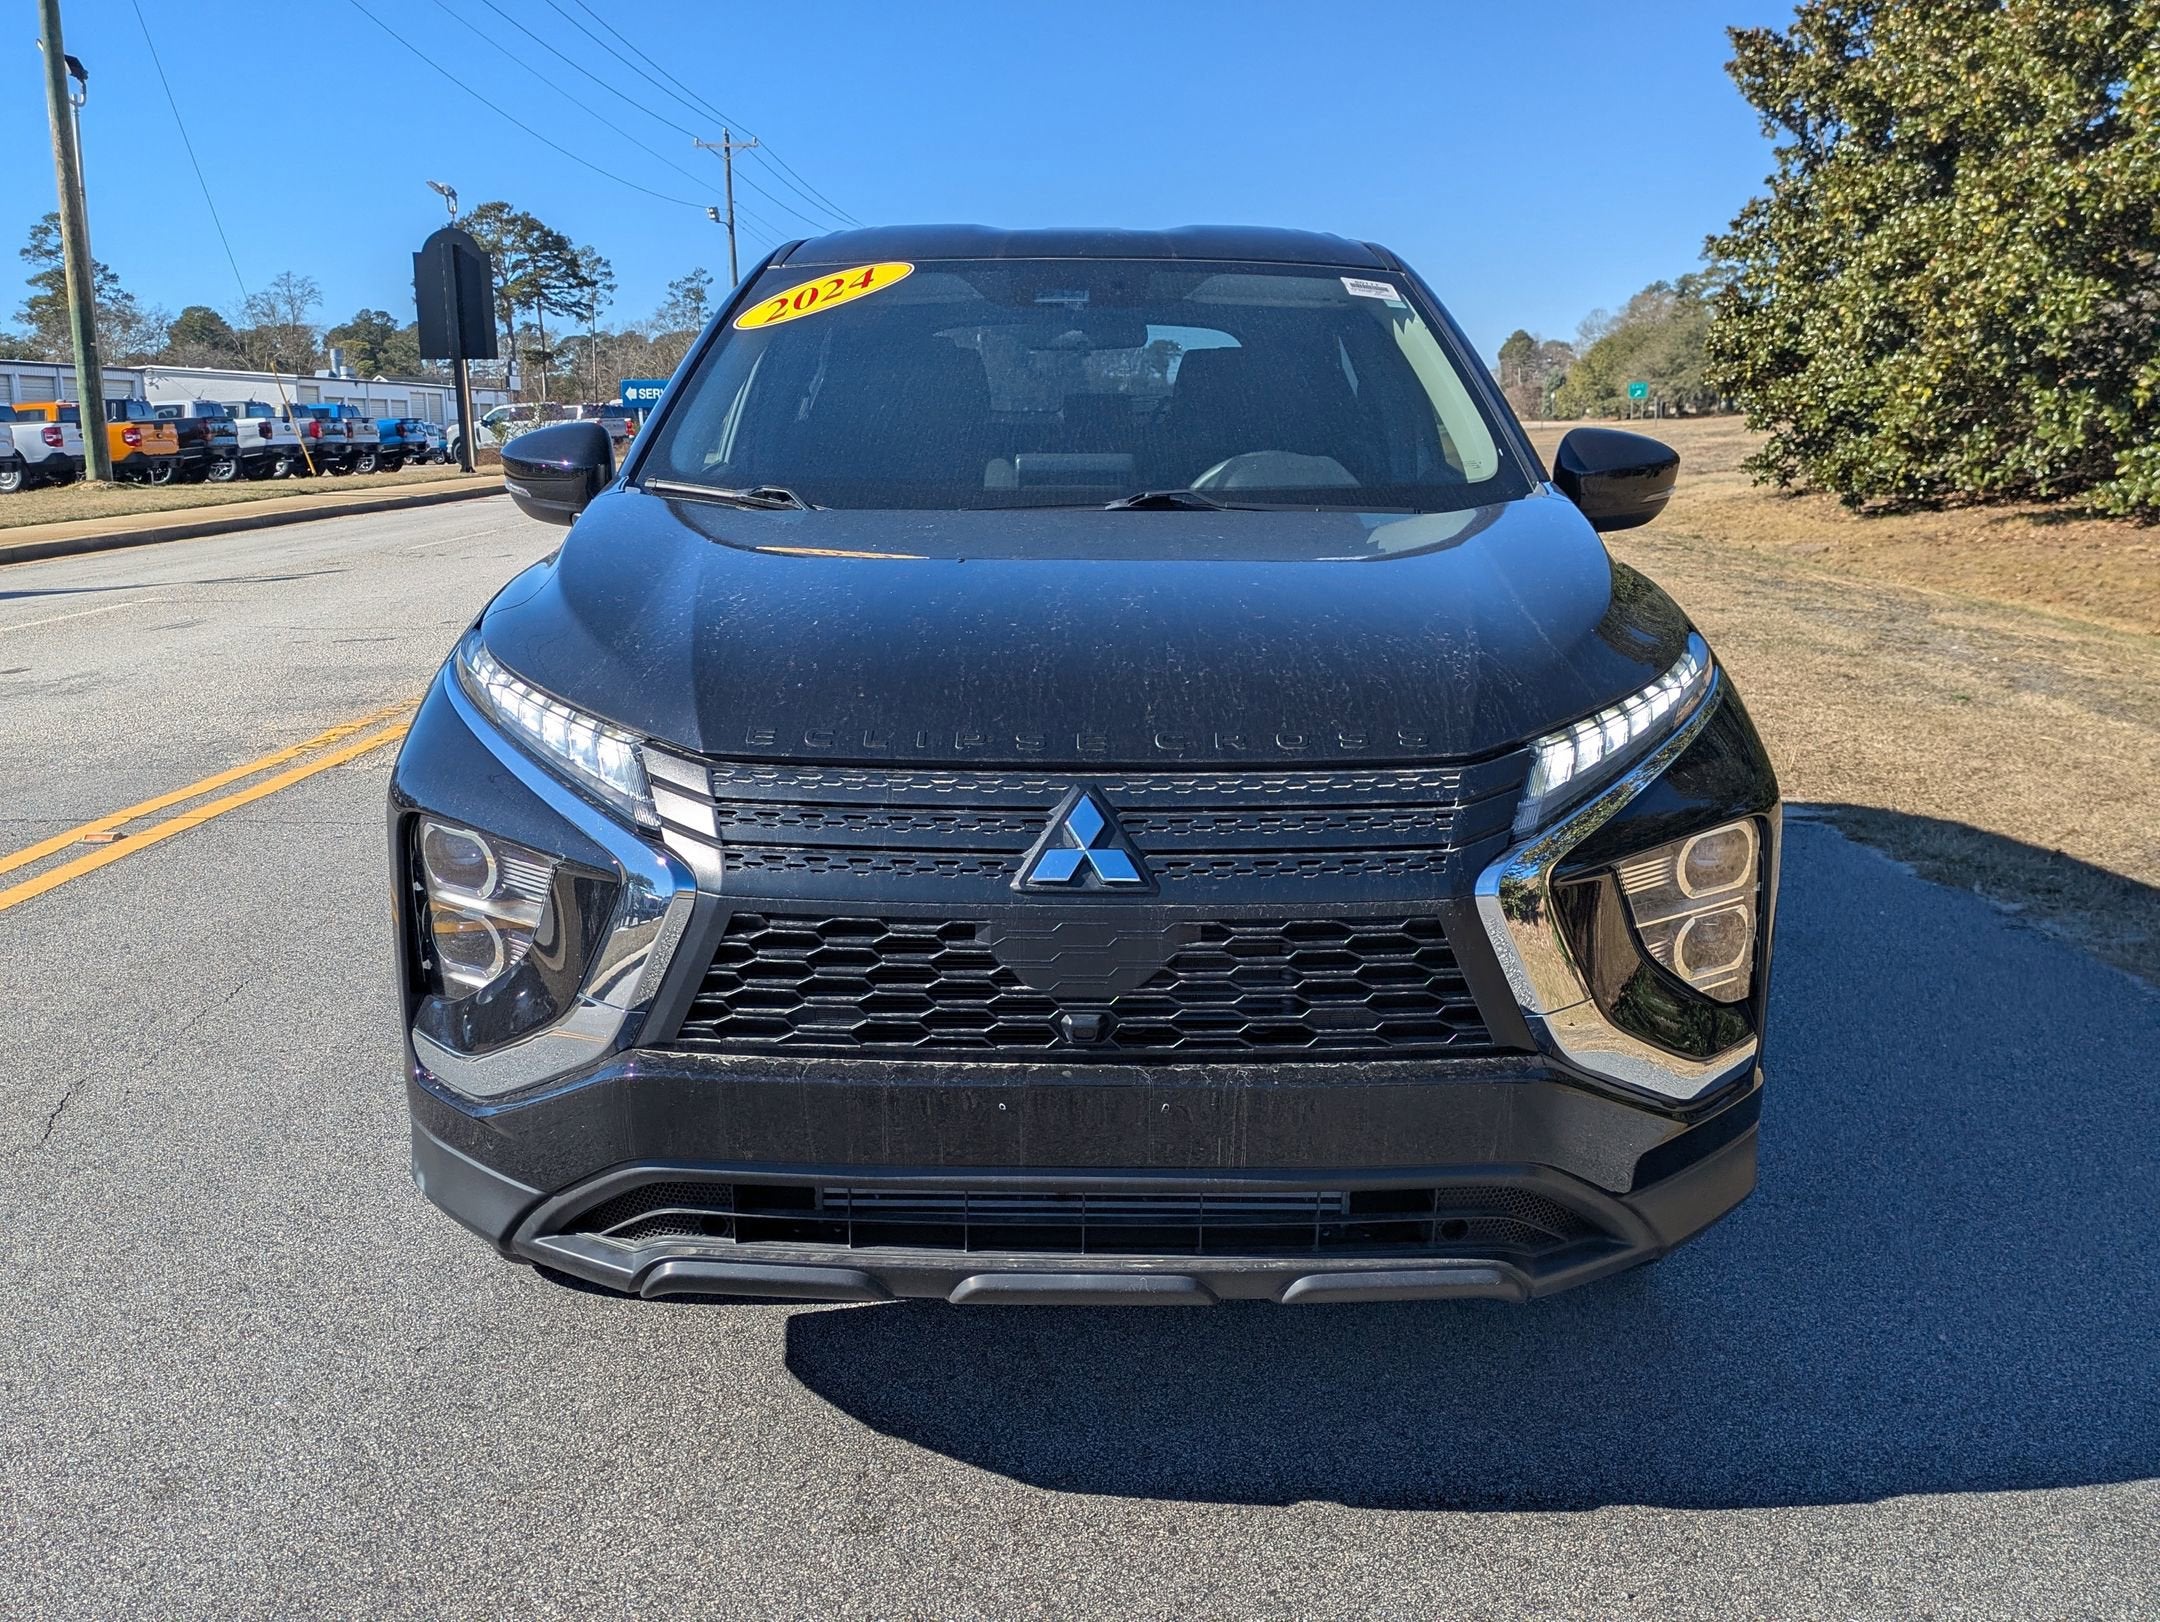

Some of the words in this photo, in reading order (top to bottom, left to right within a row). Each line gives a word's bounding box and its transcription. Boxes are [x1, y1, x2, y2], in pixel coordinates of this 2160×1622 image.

[764, 267, 875, 323] 2024
[744, 726, 1108, 751] ECLIPSE
[1154, 730, 1430, 751] CROSS
